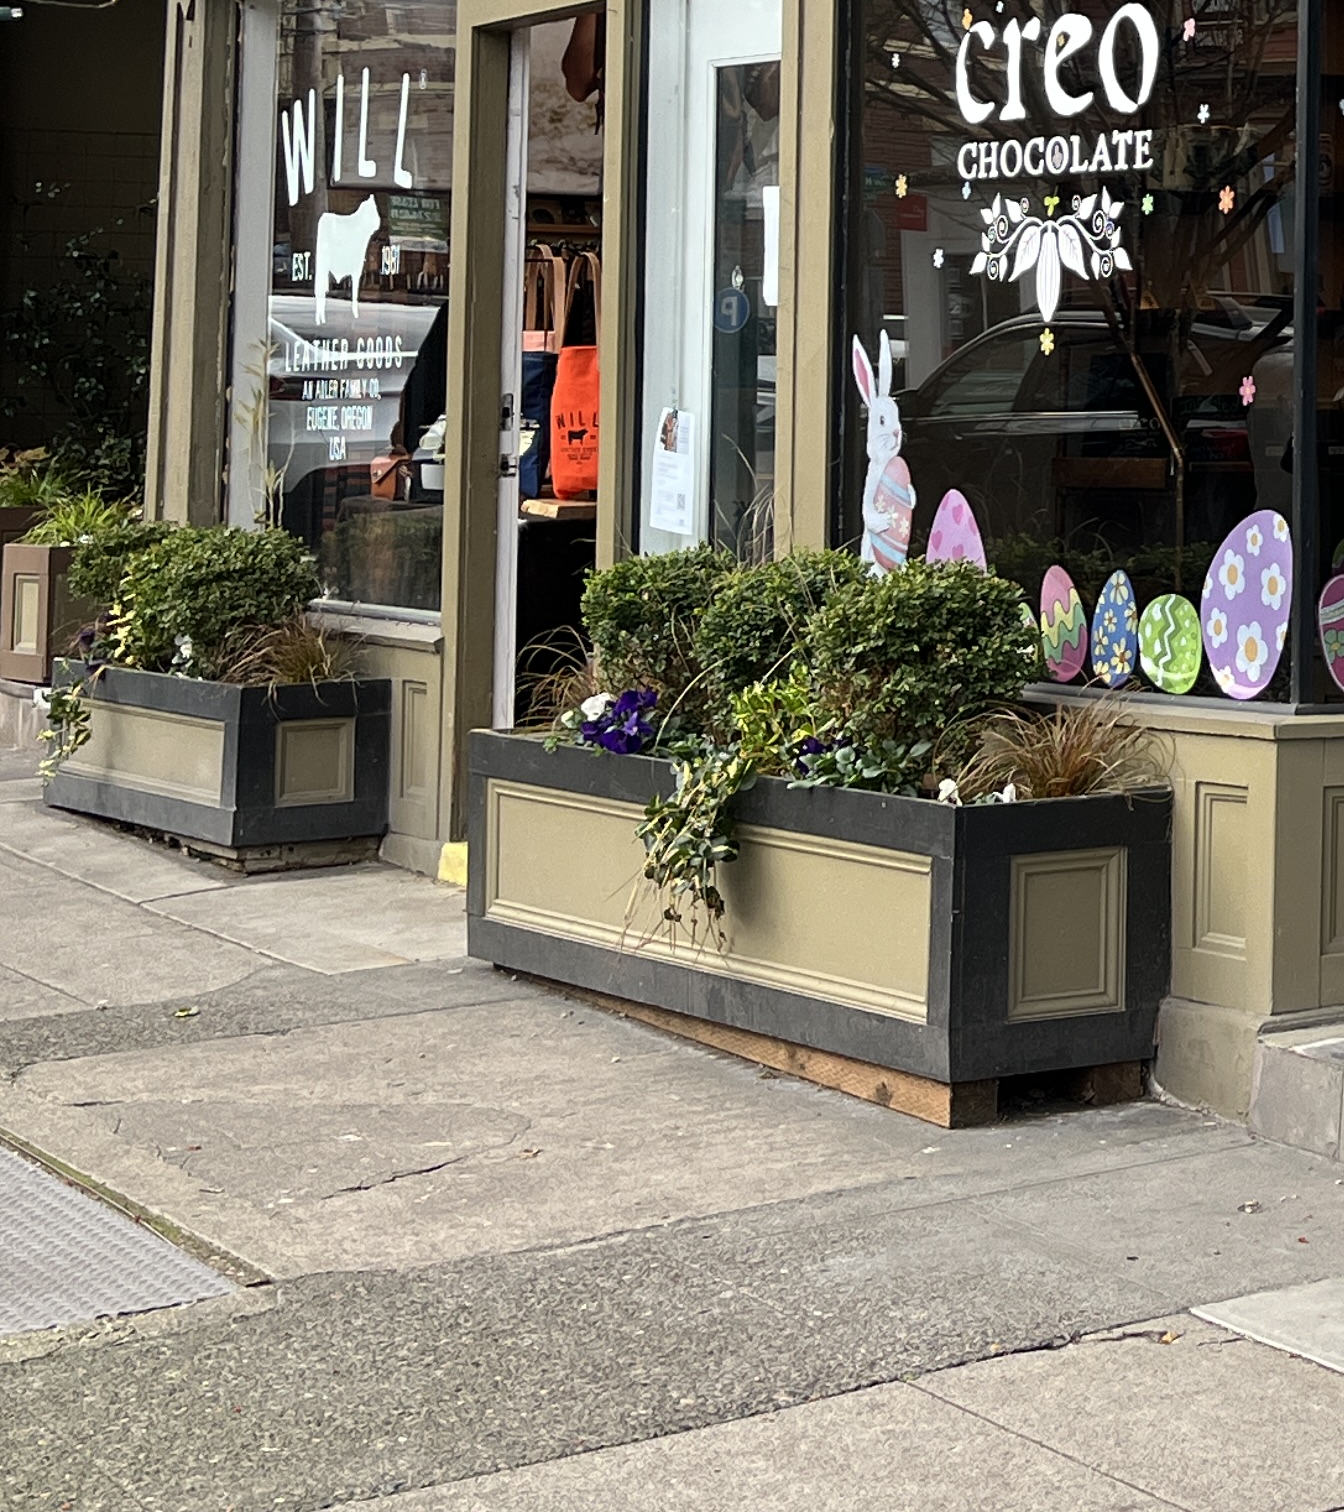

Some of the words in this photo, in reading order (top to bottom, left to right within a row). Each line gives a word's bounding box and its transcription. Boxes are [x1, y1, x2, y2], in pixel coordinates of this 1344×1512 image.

[956, 2, 1160, 124] creo
[281, 67, 413, 207] WILL
[958, 129, 1154, 179] CHOCOLATE
[291, 251, 312, 281] EST.
[380, 245, 401, 275] 1981
[285, 338, 348, 372] LEATHER
[355, 335, 403, 370] GOODS
[341, 405, 373, 431] OREGON
[329, 435, 347, 461] USA
